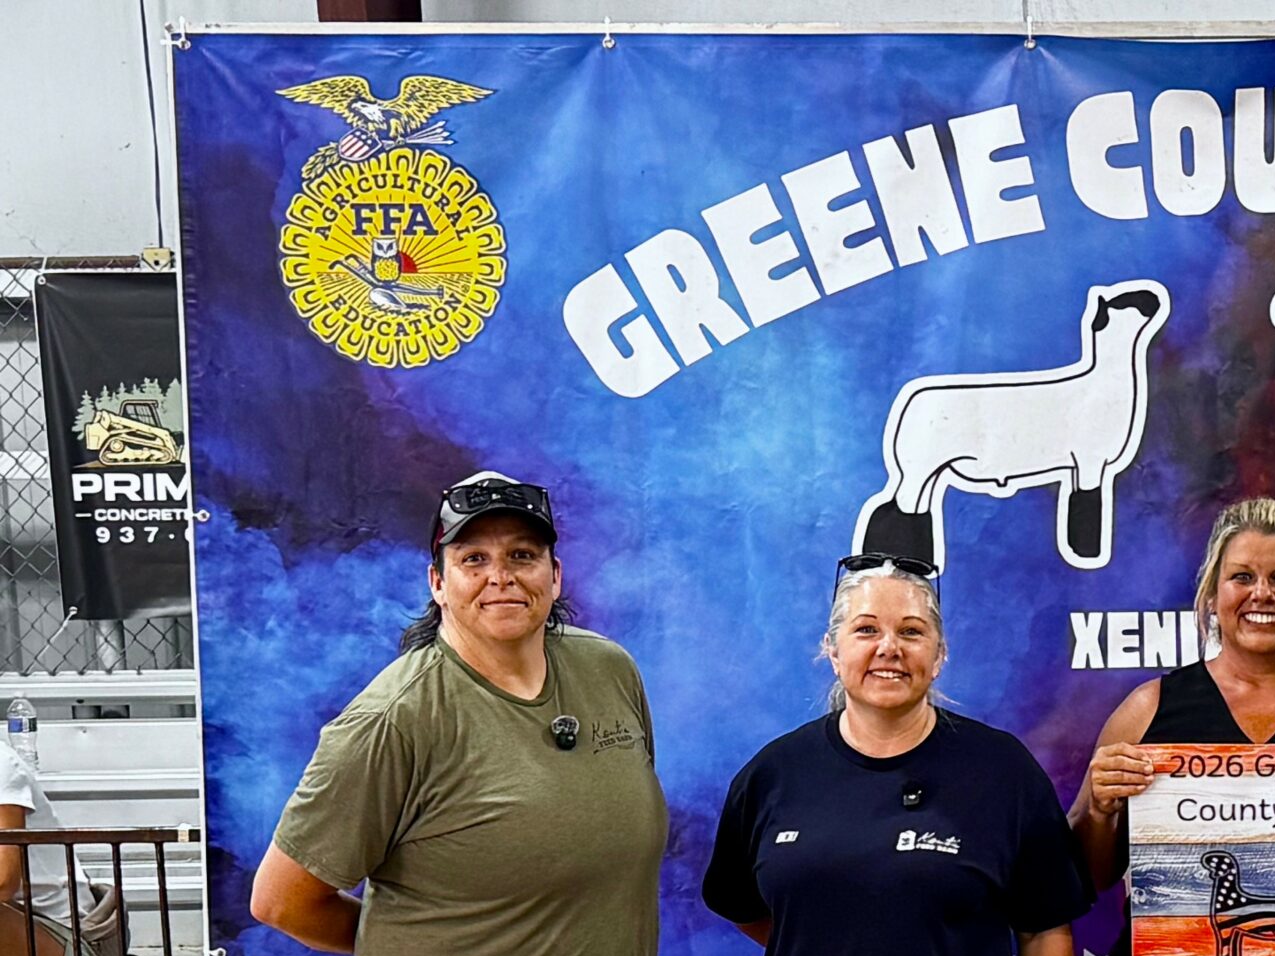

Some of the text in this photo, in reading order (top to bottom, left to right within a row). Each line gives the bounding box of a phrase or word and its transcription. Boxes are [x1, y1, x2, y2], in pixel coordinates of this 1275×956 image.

[314, 173, 471, 242] AGRICULTURAL
[350, 202, 439, 237] FFA
[563, 103, 1046, 398] GREENE
[329, 292, 463, 337] EDUCATION
[1169, 754, 1244, 779] 2026
